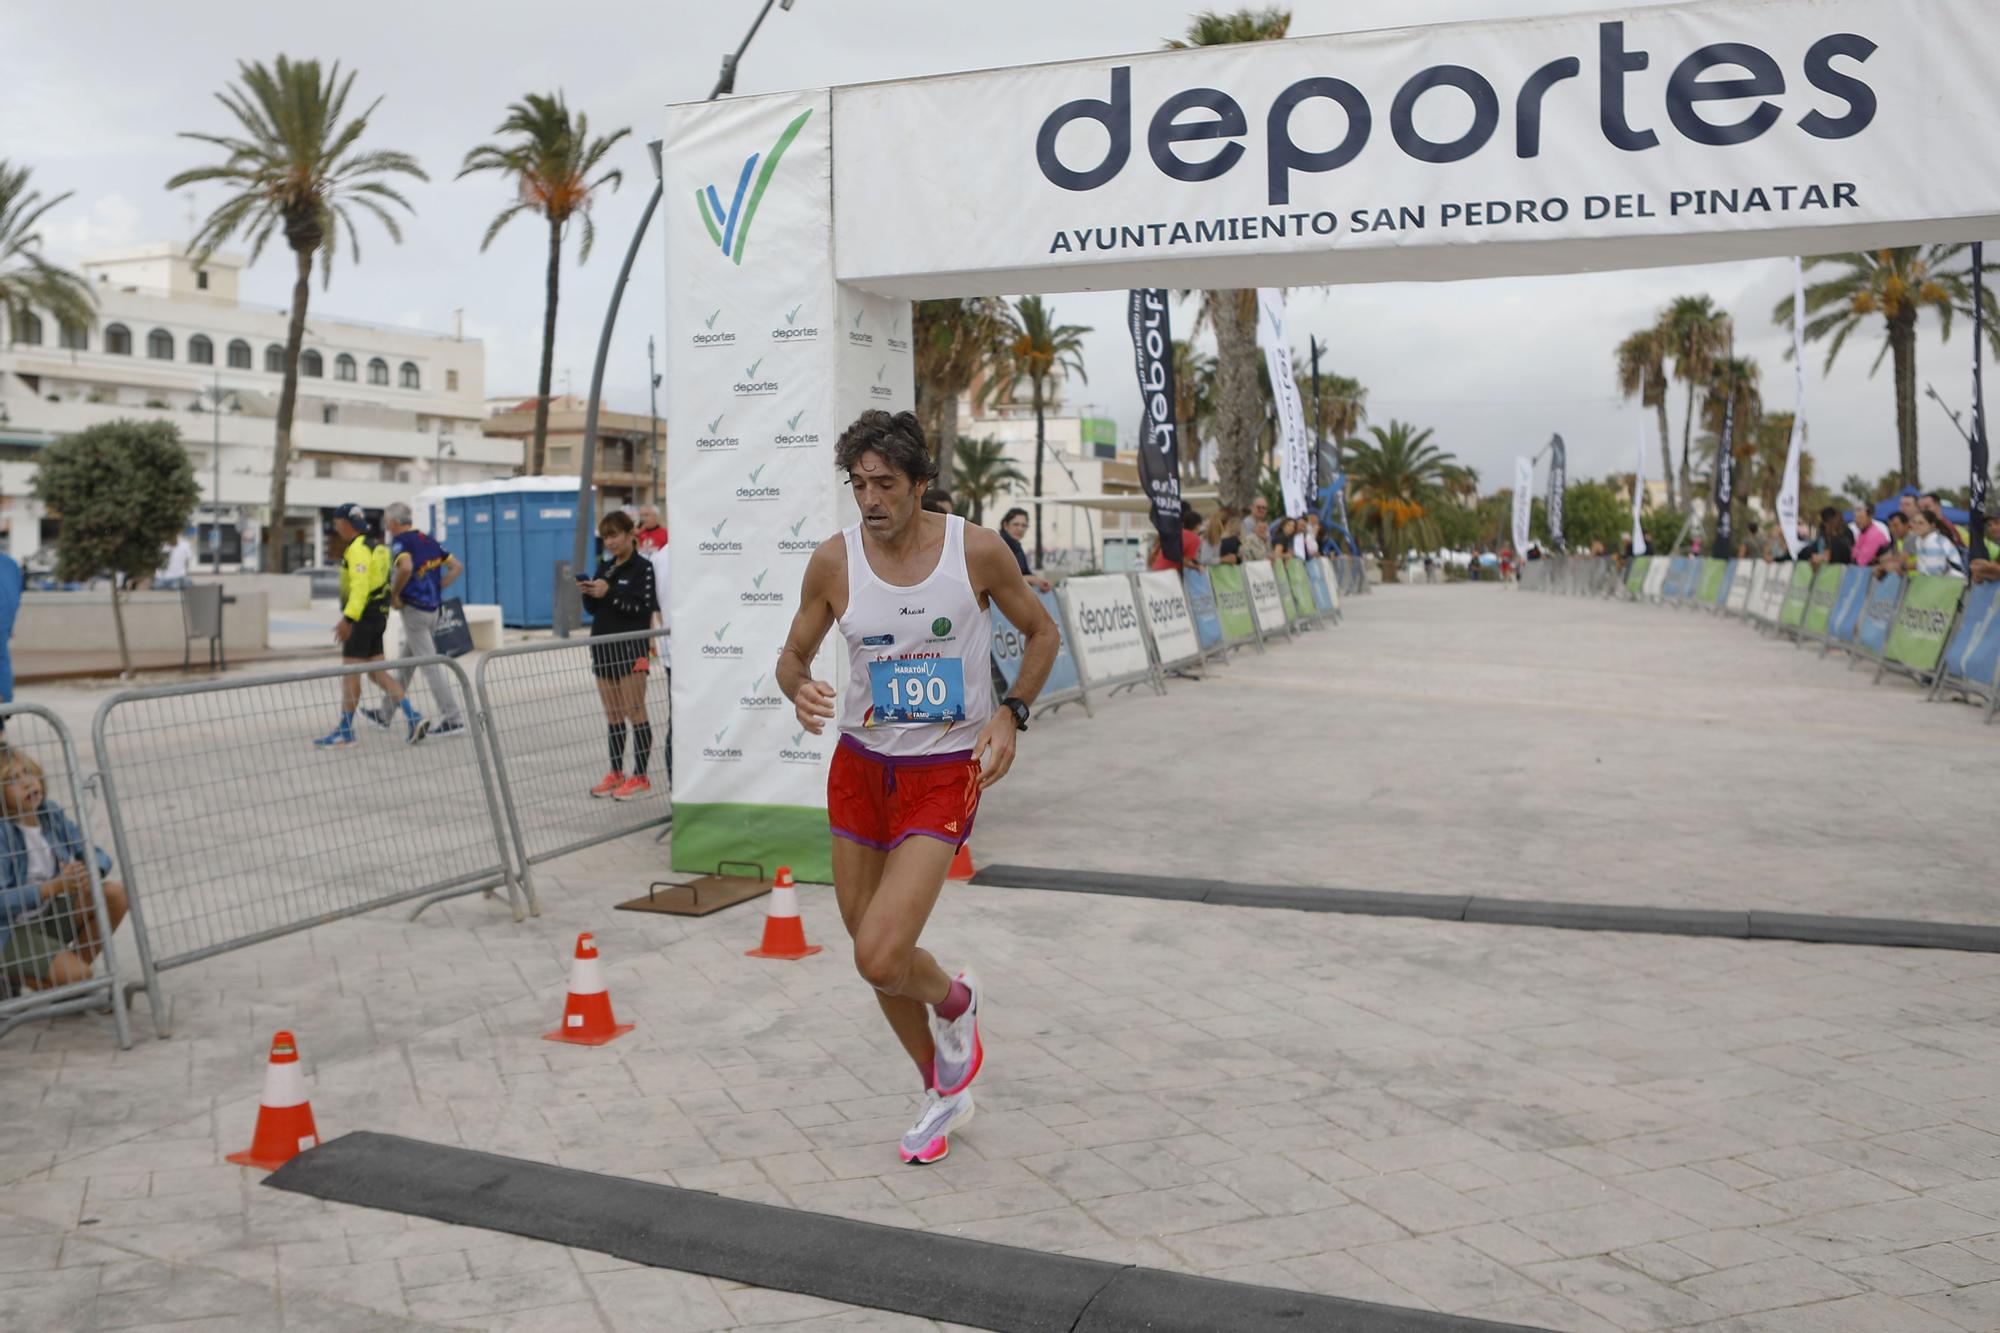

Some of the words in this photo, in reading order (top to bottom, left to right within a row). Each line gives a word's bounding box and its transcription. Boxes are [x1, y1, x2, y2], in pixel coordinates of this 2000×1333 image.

[1037, 21, 1878, 205] deportes
[1050, 212, 1337, 253] AYUNTAMIENTO
[1351, 206, 1424, 233] SAN
[1442, 198, 1568, 226] PEDRO
[1585, 195, 1654, 219] DEL
[1671, 183, 1859, 215] PINATAR
[693, 332, 736, 344] deportes
[772, 327, 818, 339] deportes
[733, 381, 778, 392] deportes
[696, 437, 739, 448] deportes
[775, 434, 818, 446] deportes
[736, 486, 779, 498] deportes
[699, 541, 742, 552] deportes
[778, 540, 819, 551] deporte
[740, 591, 783, 603] deportes
[1080, 598, 1137, 641] deportes
[702, 645, 743, 656] deportes
[887, 677, 947, 706] 190
[740, 696, 782, 706] deportes
[703, 748, 742, 757] deportes
[780, 748, 822, 760] deportes
